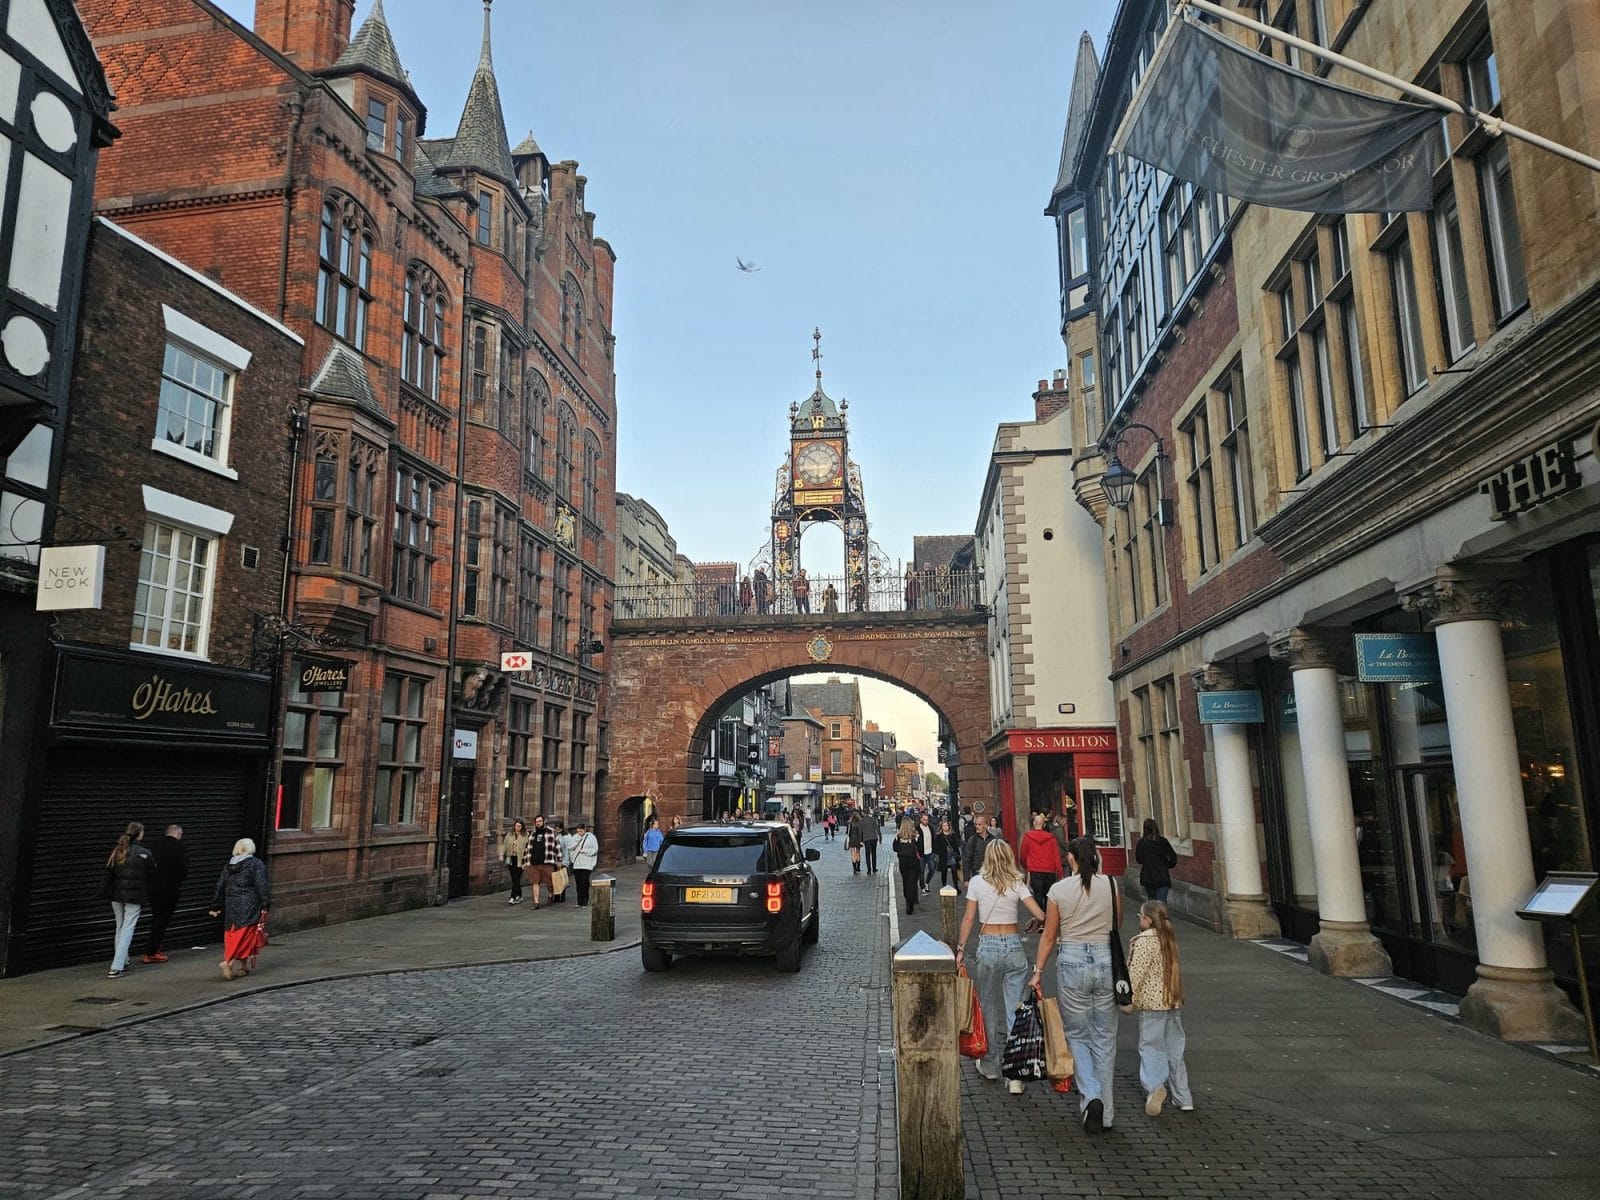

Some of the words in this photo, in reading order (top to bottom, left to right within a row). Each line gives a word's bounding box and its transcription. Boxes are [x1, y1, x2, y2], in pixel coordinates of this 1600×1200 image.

[1201, 135, 1285, 180] CHESTER
[832, 477, 842, 487] 97
[1479, 441, 1574, 522] THE
[48, 566, 87, 577] NEW
[44, 577, 89, 590] LOOK
[1378, 649, 1393, 659] La
[303, 666, 347, 686] O'Hares
[132, 674, 218, 720] O'Hares
[1024, 736, 1049, 748] S.S.
[1053, 735, 1109, 748] MILTON
